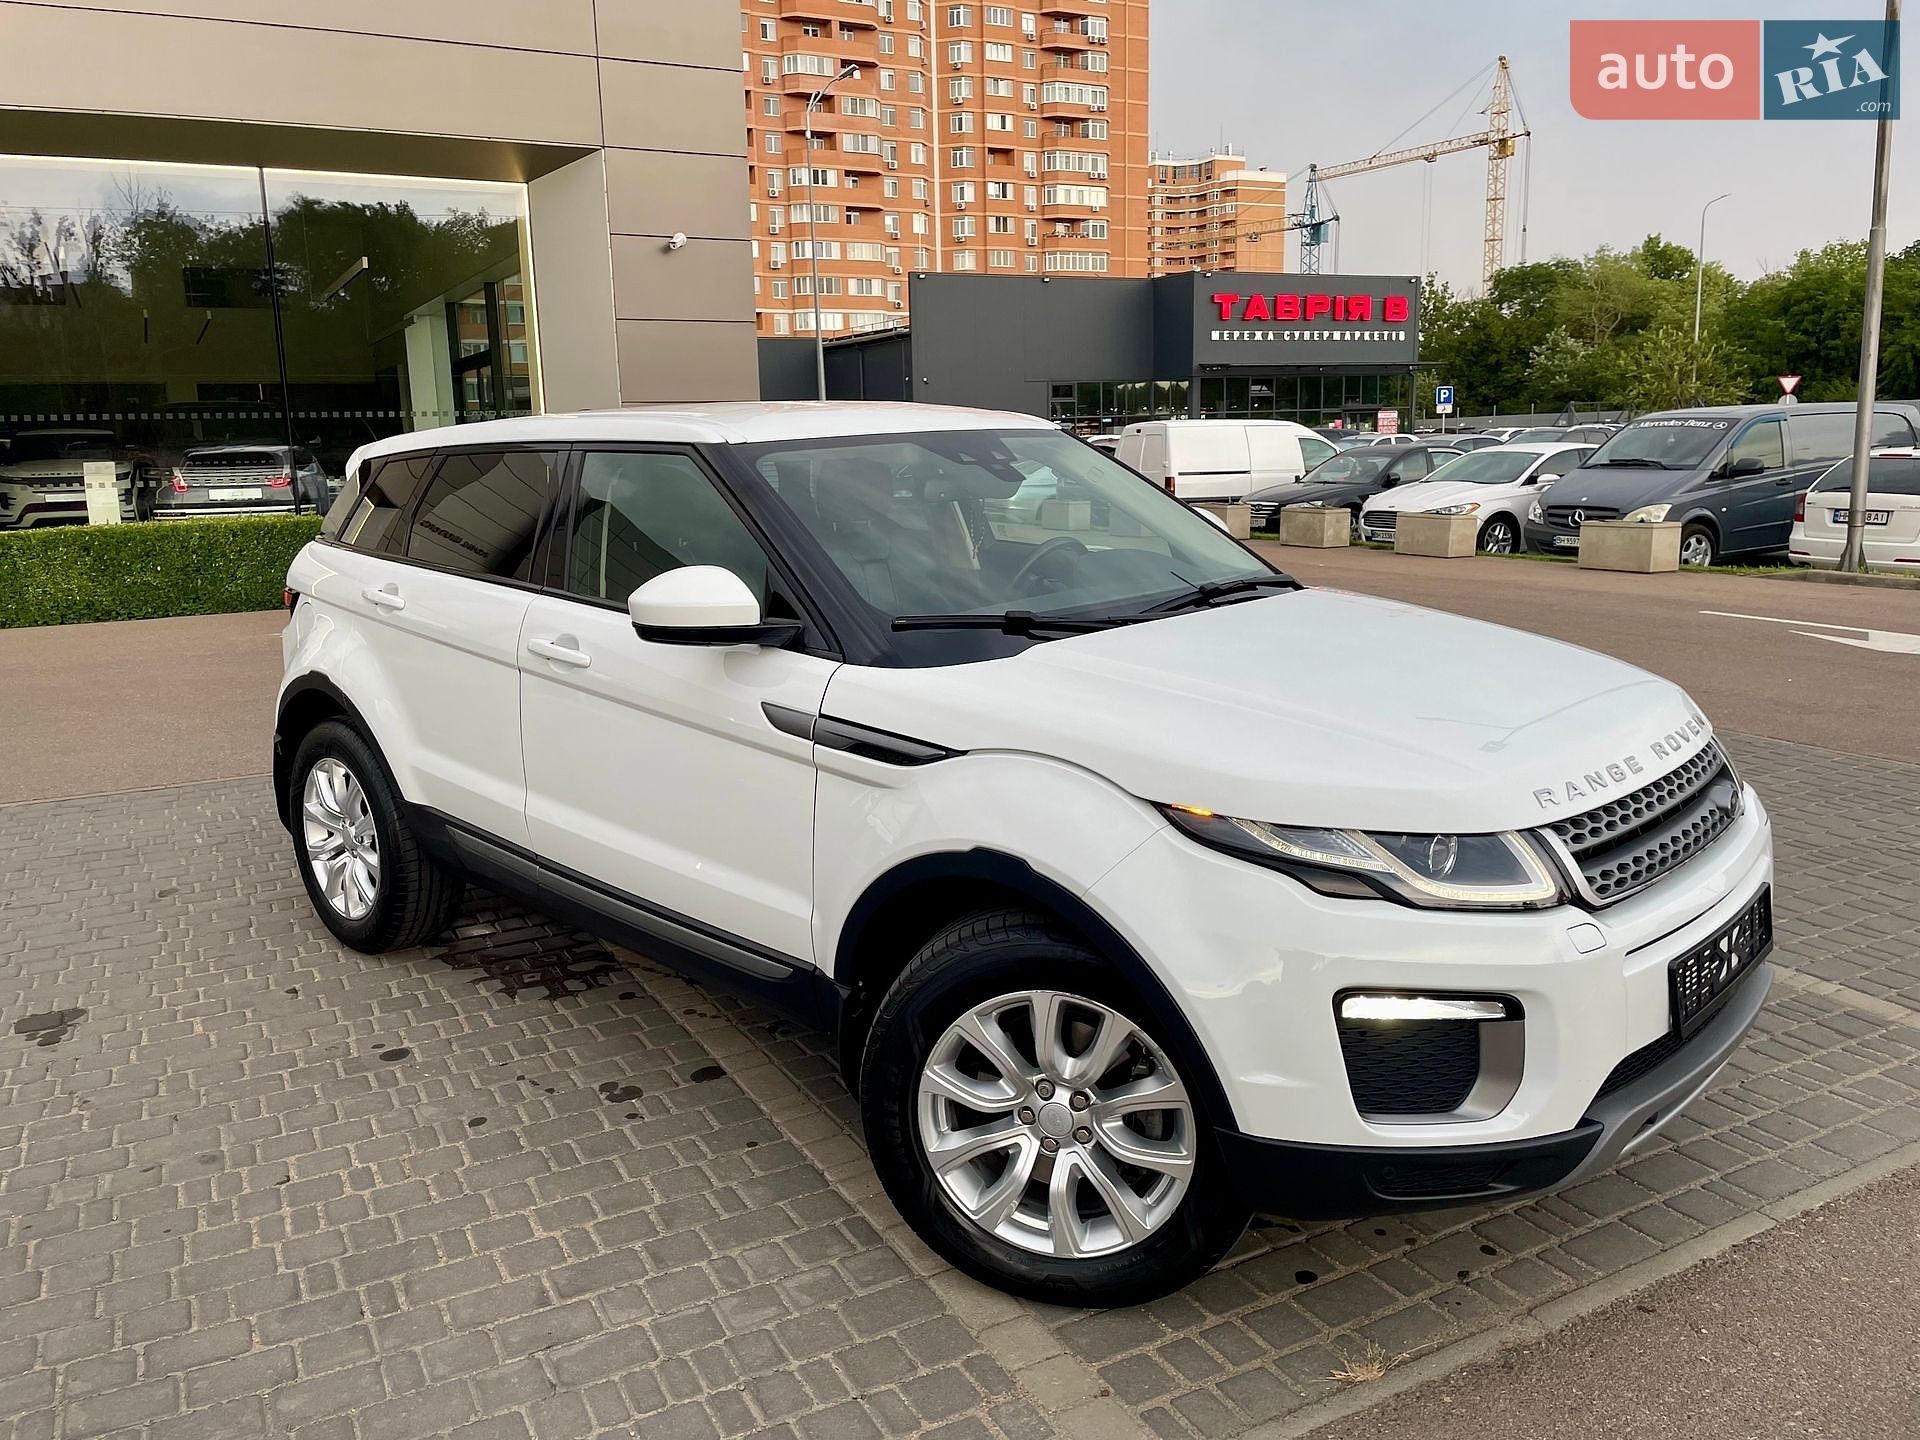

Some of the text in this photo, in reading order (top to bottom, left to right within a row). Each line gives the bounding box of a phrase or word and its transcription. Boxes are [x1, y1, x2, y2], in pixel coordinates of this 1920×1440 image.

[1213, 293, 1410, 322] ТАВРІЯ В
[1210, 330, 1406, 342] МЕРЕЖА СУПЕРМАРКЕТІВ
[1440, 389, 1449, 402] P
[1640, 419, 1713, 429] Mercedes-Benz
[1532, 713, 1706, 809] RANGE ROVER
